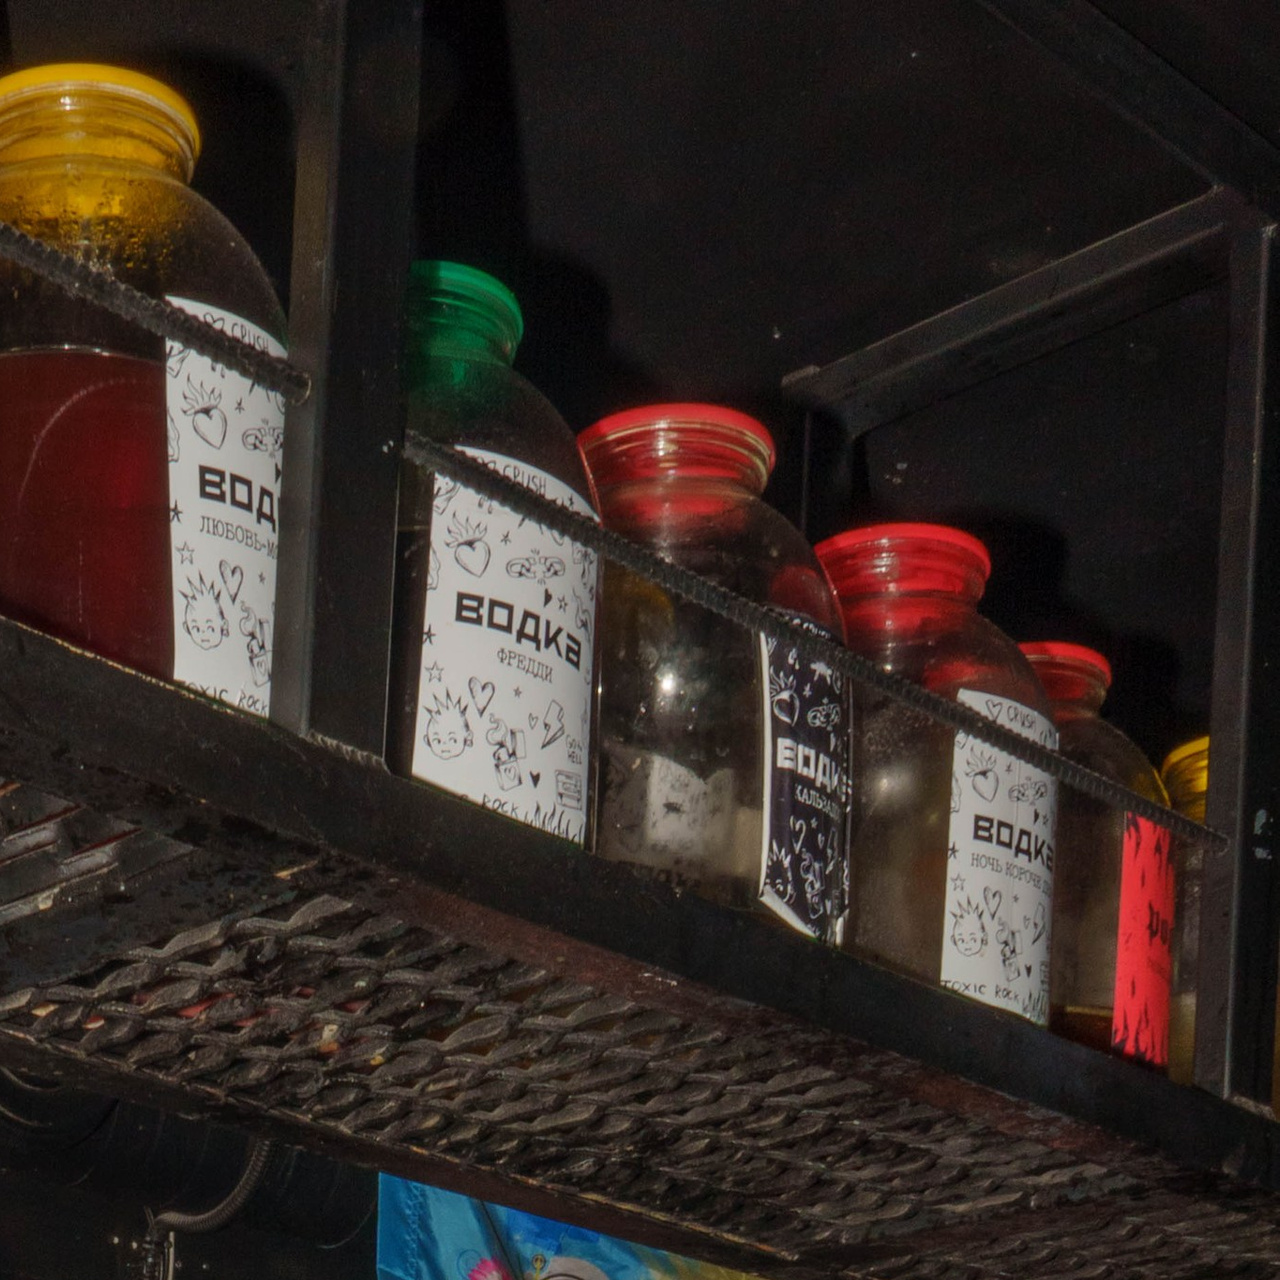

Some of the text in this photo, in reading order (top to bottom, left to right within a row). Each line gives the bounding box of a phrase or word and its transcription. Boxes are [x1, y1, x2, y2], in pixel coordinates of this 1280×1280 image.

[198, 464, 277, 533] ВОД
[200, 514, 278, 560] ЛЮБОВЬ-М
[497, 646, 553, 685] ФРЕДДИ
[970, 852, 1003, 873] НОЧЬ
